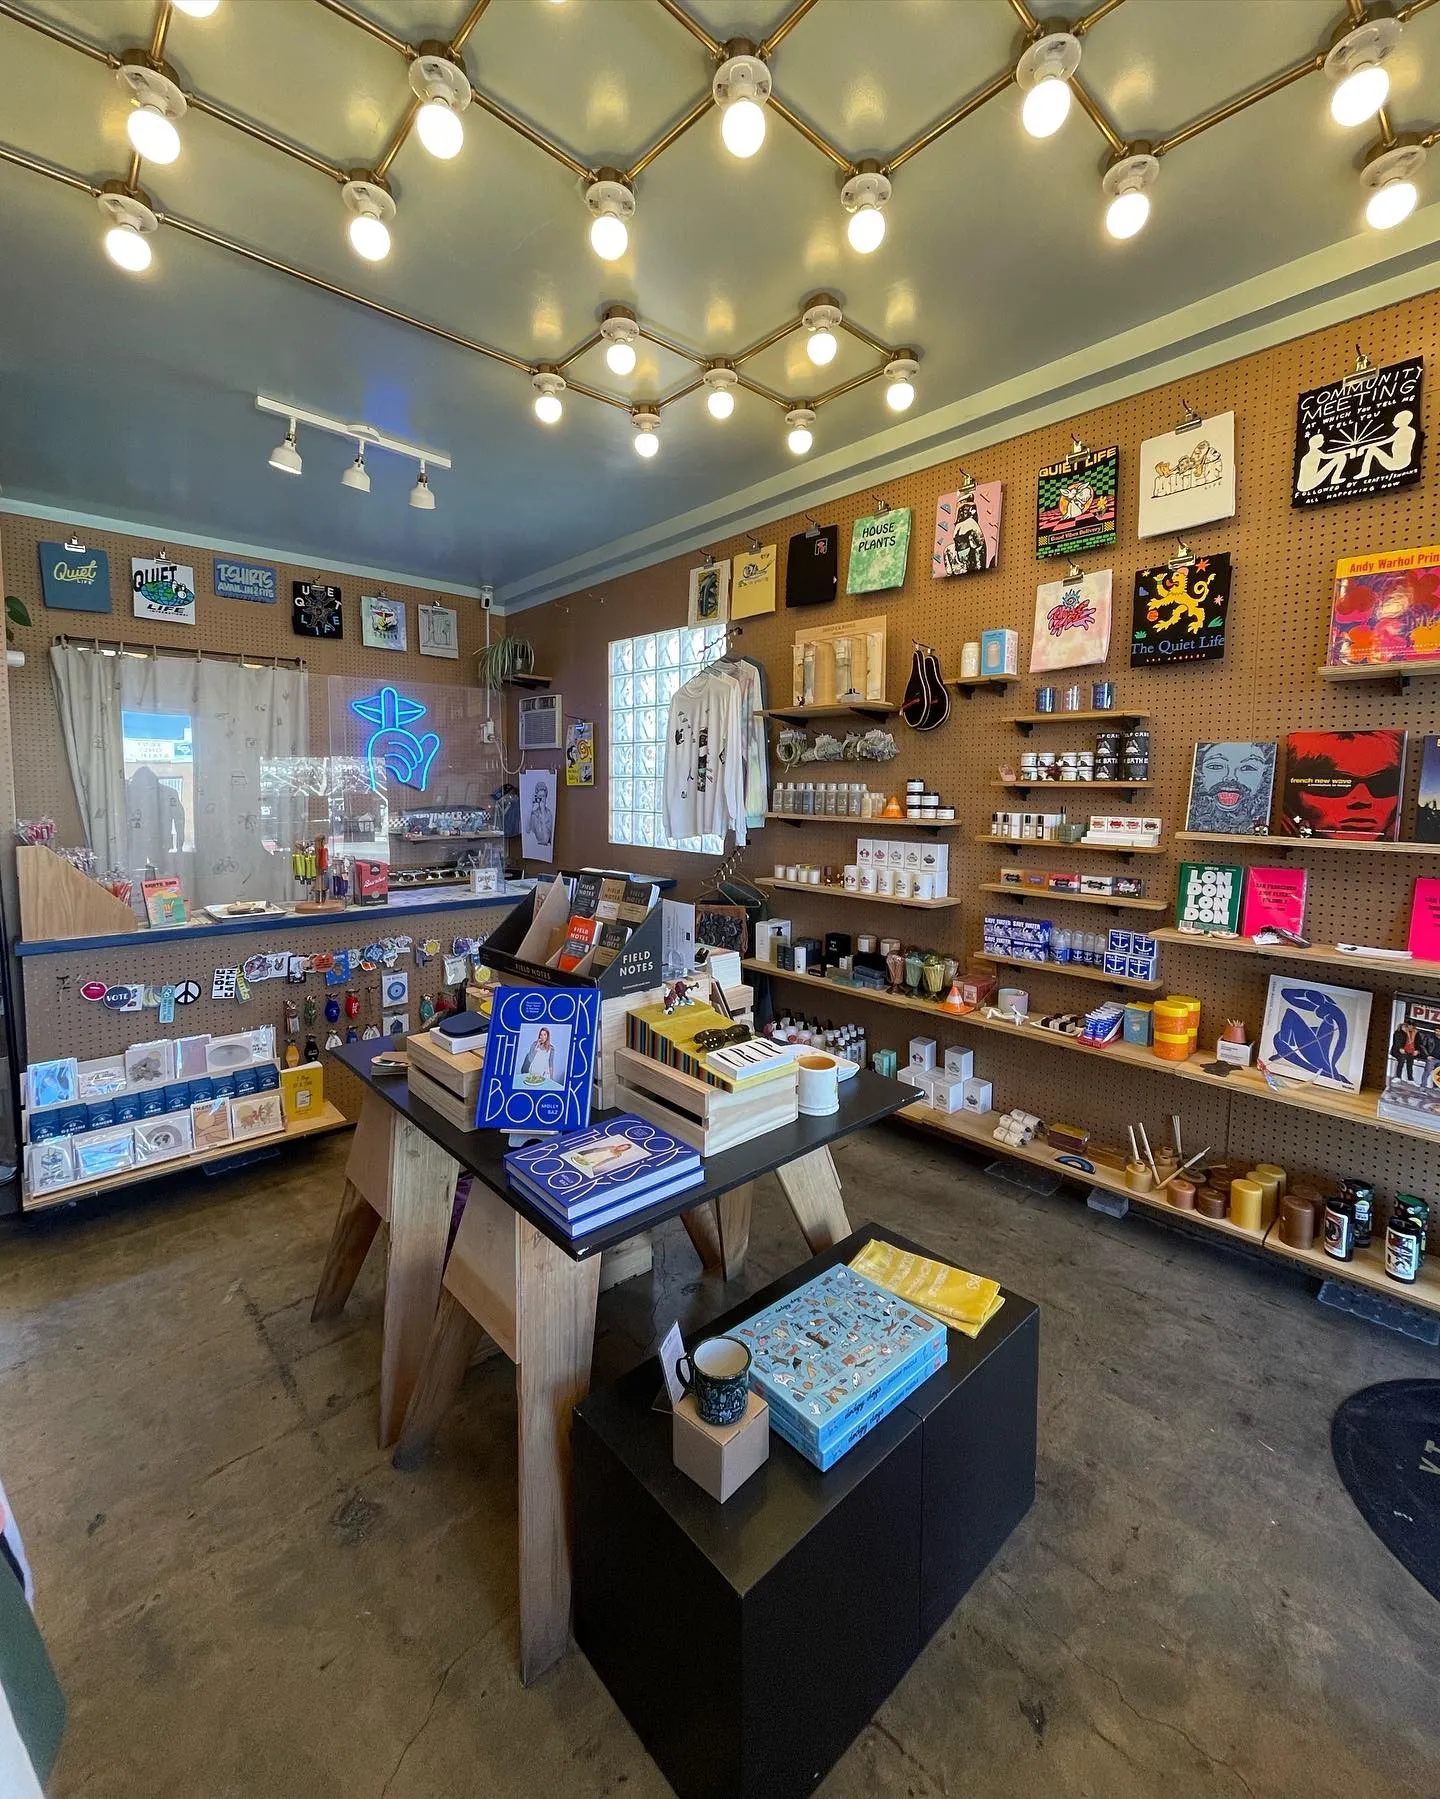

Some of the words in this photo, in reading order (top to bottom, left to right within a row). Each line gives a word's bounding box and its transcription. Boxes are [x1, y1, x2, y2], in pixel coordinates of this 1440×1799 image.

[1301, 366, 1424, 411] COMMUNITY
[1302, 379, 1417, 424] MEETING
[1305, 421, 1317, 430] AT
[1322, 411, 1352, 425] WHICH
[1376, 400, 1396, 409] TELL
[1328, 420, 1354, 431] TELL
[1360, 411, 1381, 422] YOU
[1039, 461, 1078, 478] QUIET
[1085, 447, 1117, 467] LIFE
[1294, 484, 1340, 499] FOLLOWED
[862, 521, 896, 539] HOUSE
[858, 535, 896, 553] PLANTS
[54, 560, 98, 581] Quiet
[1349, 561, 1374, 573] Andy
[1378, 555, 1414, 569] Warhol
[133, 566, 177, 592] QUIET
[147, 604, 185, 613] LIFE
[1131, 643, 1155, 655] The
[1158, 637, 1196, 655] Quiet
[1199, 634, 1225, 648] Life
[1190, 869, 1232, 886] LON
[1187, 882, 1233, 899] DON
[1187, 894, 1229, 912] LON
[1183, 906, 1230, 925] DON
[570, 933, 589, 941] NOTES
[574, 926, 589, 934] FIELD
[622, 951, 651, 964] FIELD
[619, 962, 654, 977] NOTES
[215, 969, 226, 994] LOVE
[106, 993, 128, 1002] VOTE
[500, 992, 593, 1035] COOK
[485, 1077, 584, 1126] BOOK
[61, 1124, 86, 1134] GEMINI
[92, 1119, 113, 1127] CANCER
[605, 1119, 692, 1167] COOK
[515, 1143, 612, 1202] BOOK
